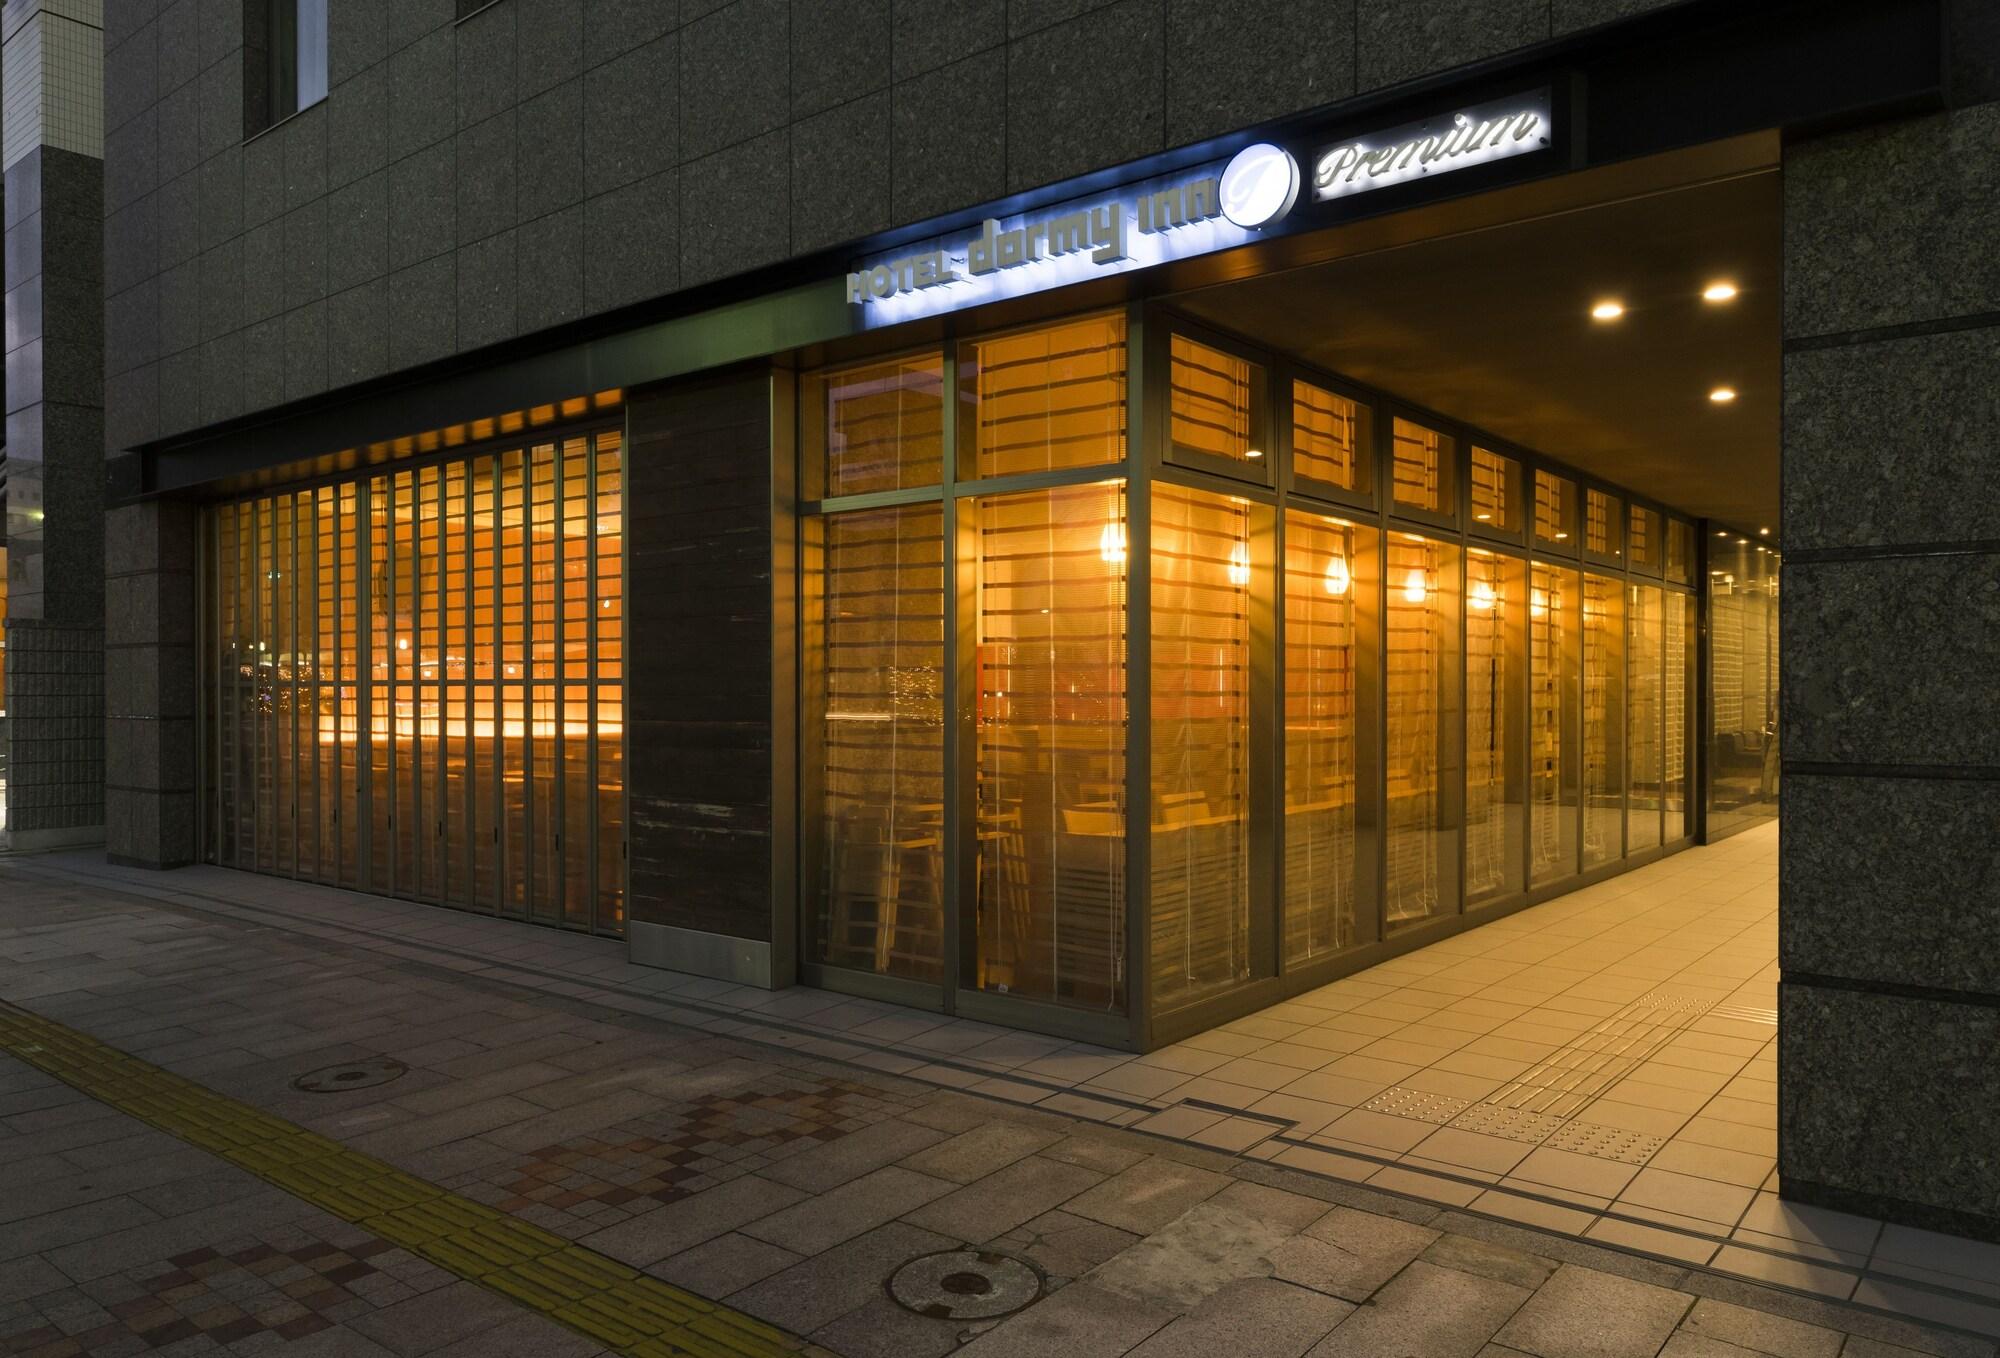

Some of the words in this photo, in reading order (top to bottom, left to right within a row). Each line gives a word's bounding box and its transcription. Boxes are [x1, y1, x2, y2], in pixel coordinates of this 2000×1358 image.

[1314, 112, 1539, 188] Premium
[846, 250, 961, 304] HOTEL
[968, 204, 1127, 276] dormy
